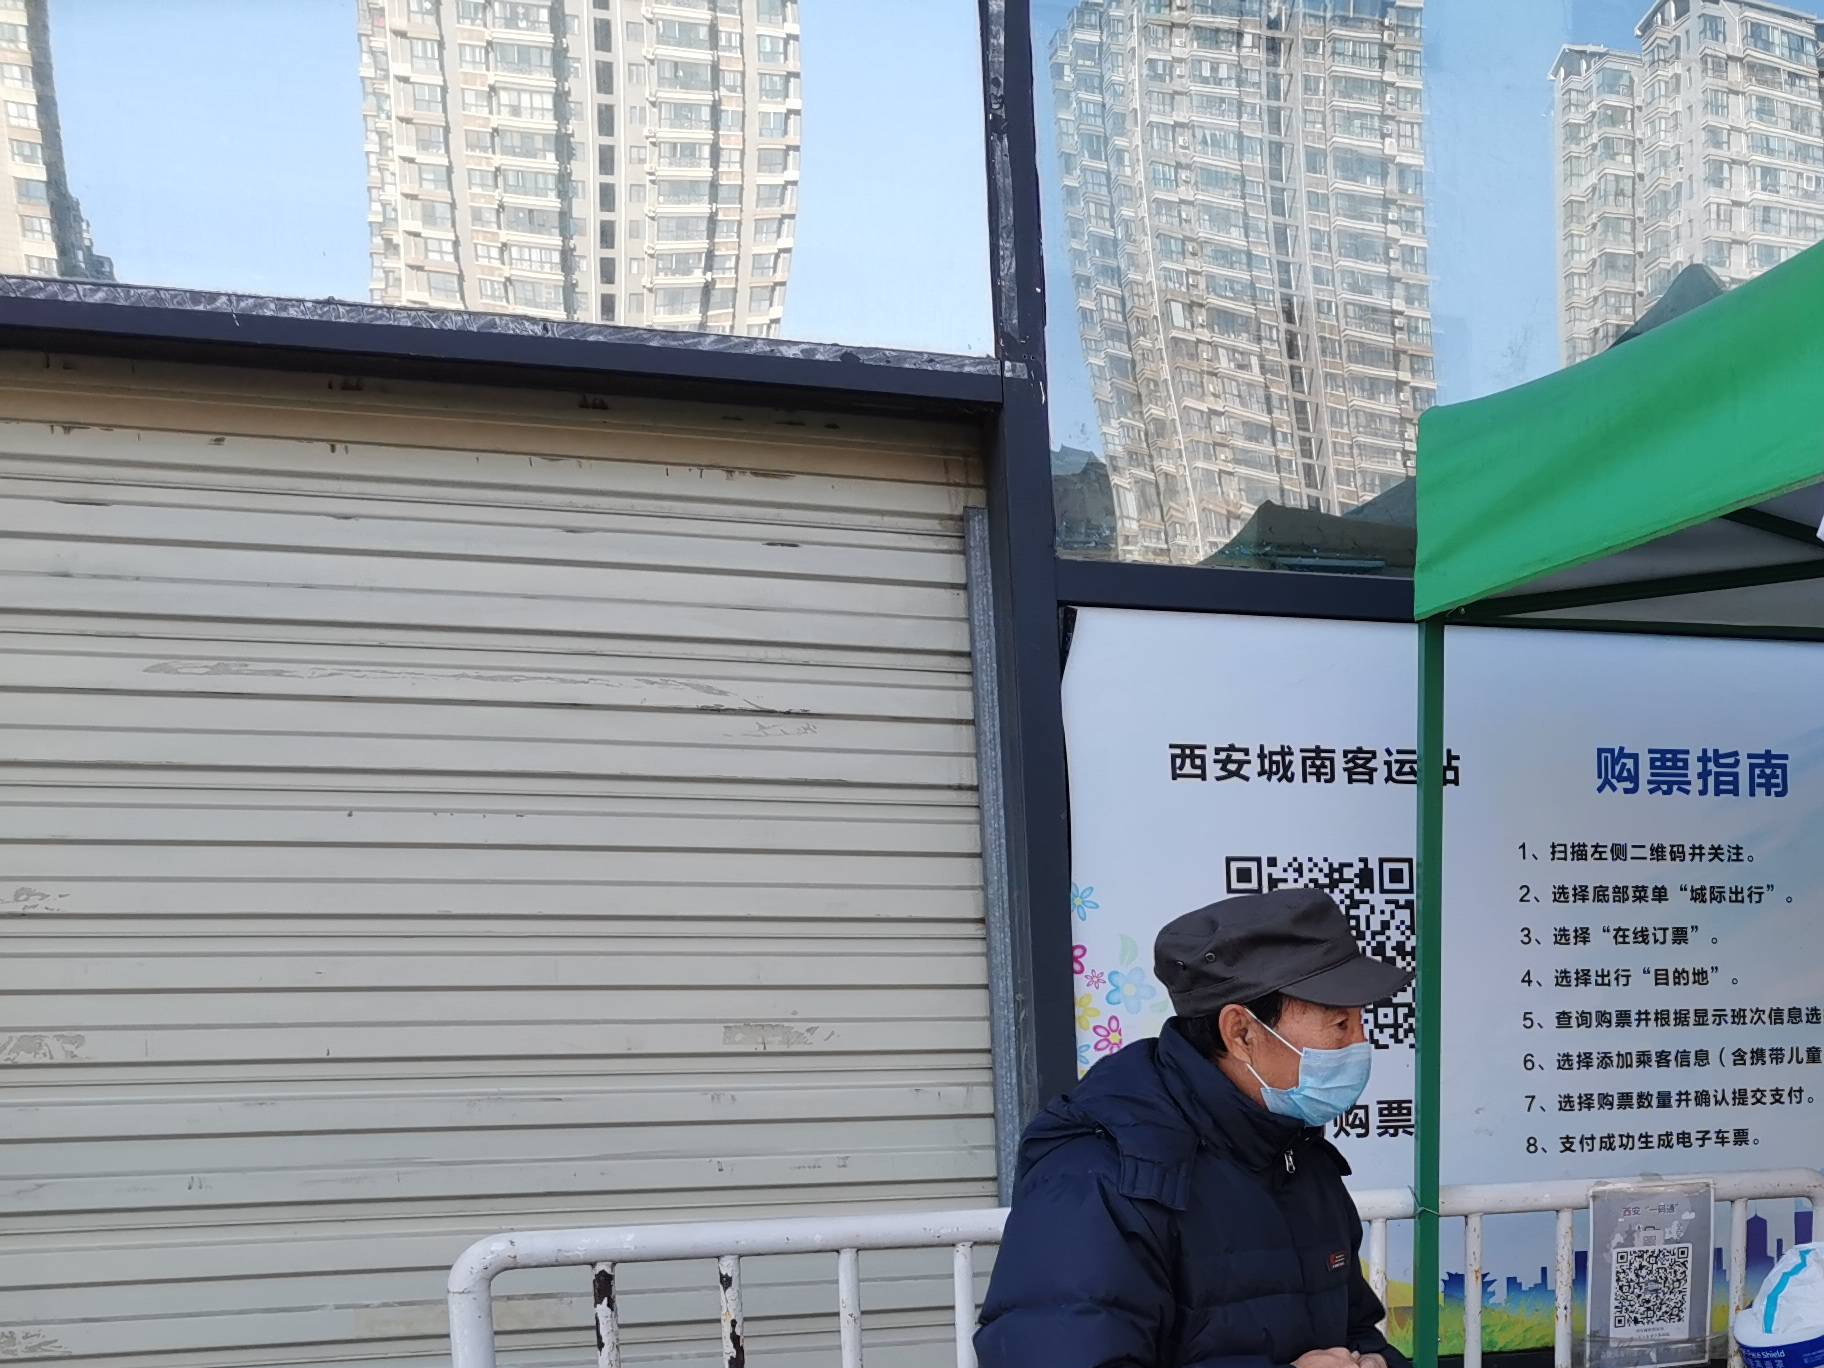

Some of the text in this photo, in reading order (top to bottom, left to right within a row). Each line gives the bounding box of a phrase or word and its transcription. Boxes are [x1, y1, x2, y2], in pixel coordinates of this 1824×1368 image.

[1595, 746, 1790, 799] 购票指南
[1517, 842, 1755, 864] 1、扫描左侧二维码并关注。
[1518, 884, 1794, 905] 2、选择底部菜单“城际出行”。
[1519, 925, 1719, 947] 3、选择“在线订票”。
[1520, 966, 1739, 989] 4、选择出行“目的地”。
[1524, 1086, 1815, 1114] 7、选择购票数量并确认提交支付。
[1323, 1098, 1415, 1139] 购票
[1525, 1128, 1761, 1155] 8、支付成功生成电子车票。
[1761, 1349, 1786, 1359] Shield
